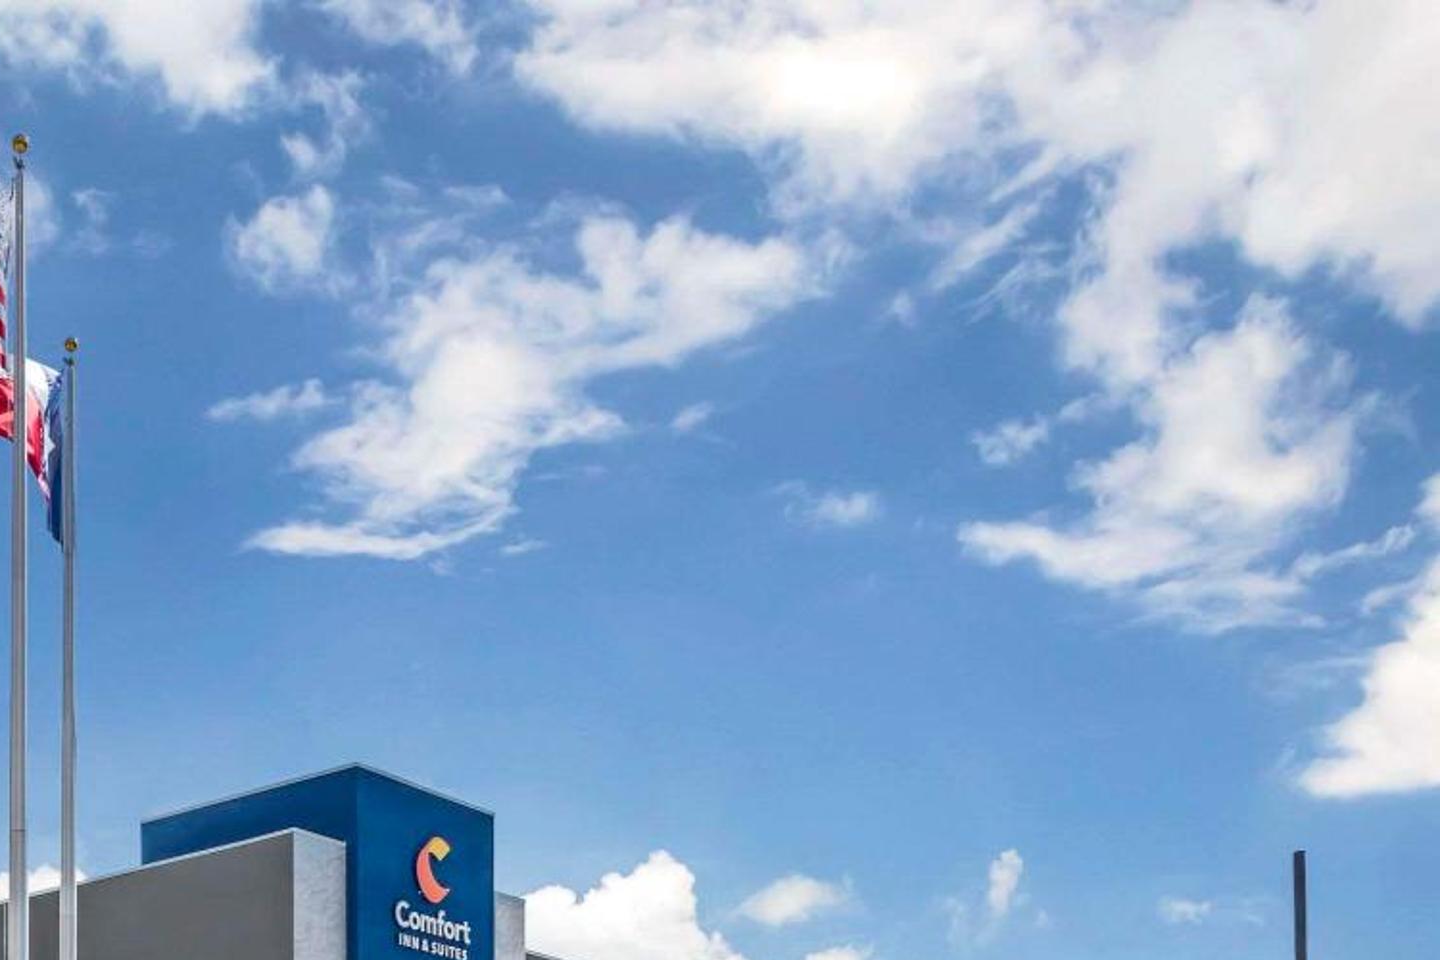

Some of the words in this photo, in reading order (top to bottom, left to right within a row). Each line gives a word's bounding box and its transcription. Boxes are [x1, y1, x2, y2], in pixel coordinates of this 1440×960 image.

[394, 900, 472, 945] Comfort
[398, 932, 420, 951] INN
[421, 938, 430, 953] &
